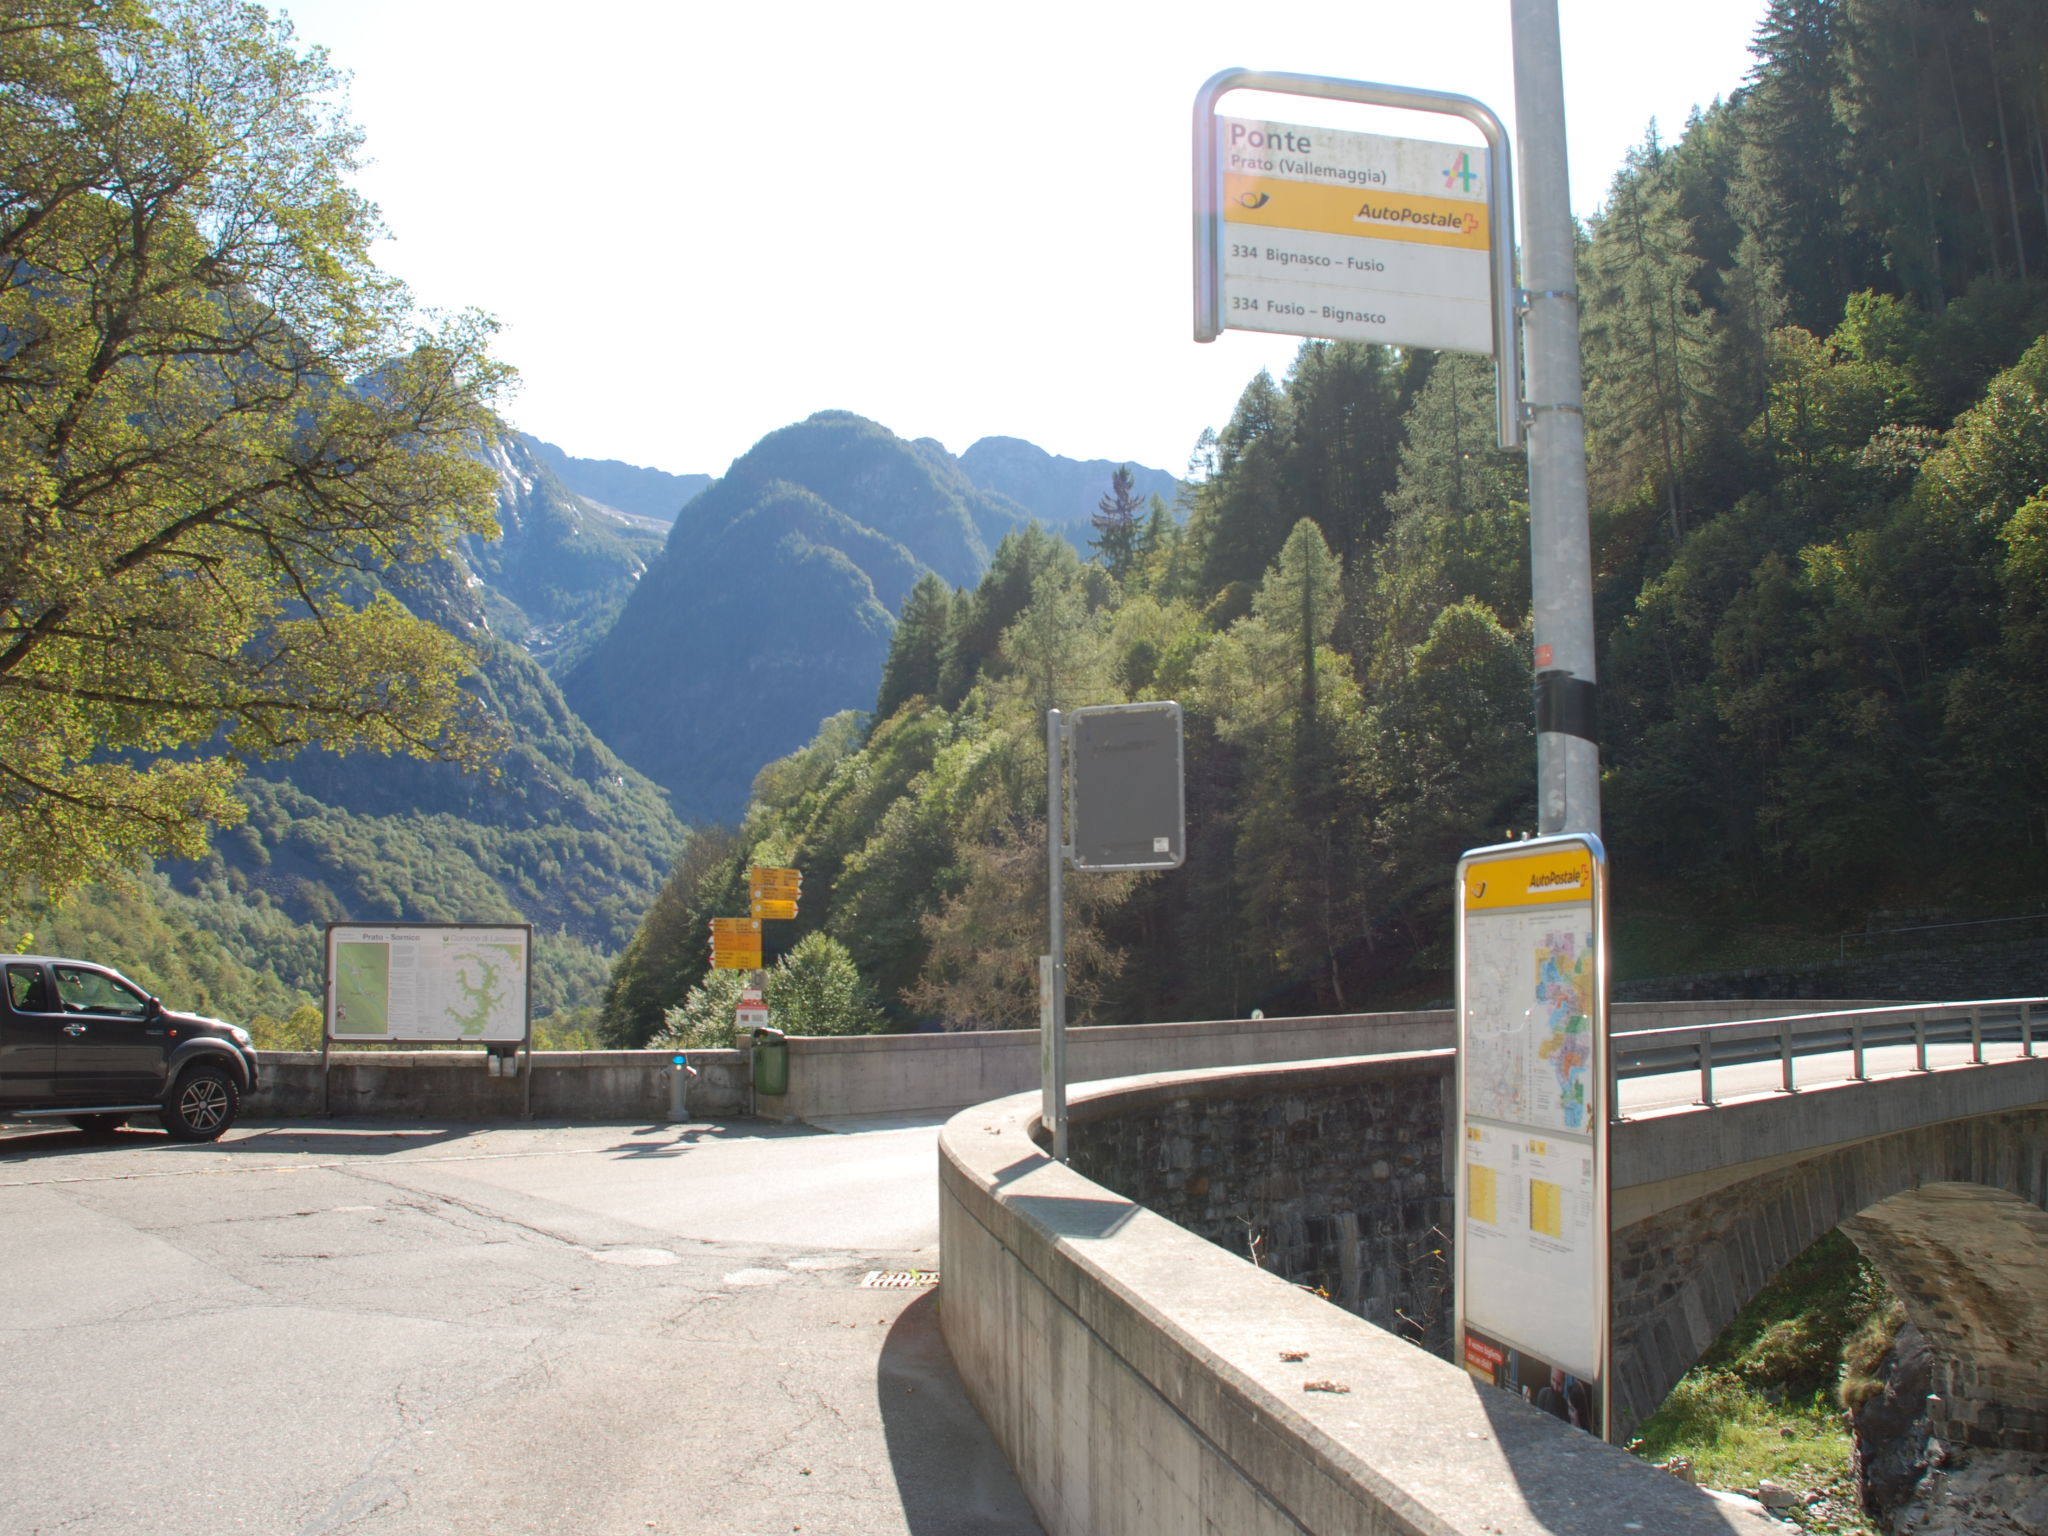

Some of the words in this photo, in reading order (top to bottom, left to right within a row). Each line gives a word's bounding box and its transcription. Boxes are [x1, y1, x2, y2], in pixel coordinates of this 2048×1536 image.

[1230, 122, 1312, 154] Ponte
[1230, 153, 1274, 172] Prato
[1278, 158, 1388, 185] (Vallemaggia)
[1358, 203, 1462, 229] AutoPostale
[1231, 244, 1258, 260] 334
[1266, 248, 1331, 268] Bignasco
[1347, 257, 1385, 273] Fusio
[1232, 297, 1259, 311] 334
[1266, 300, 1305, 316] Fusio
[1321, 306, 1387, 325] Bignasco
[1529, 869, 1581, 888] AutoPostale
[362, 933, 384, 941] Prato
